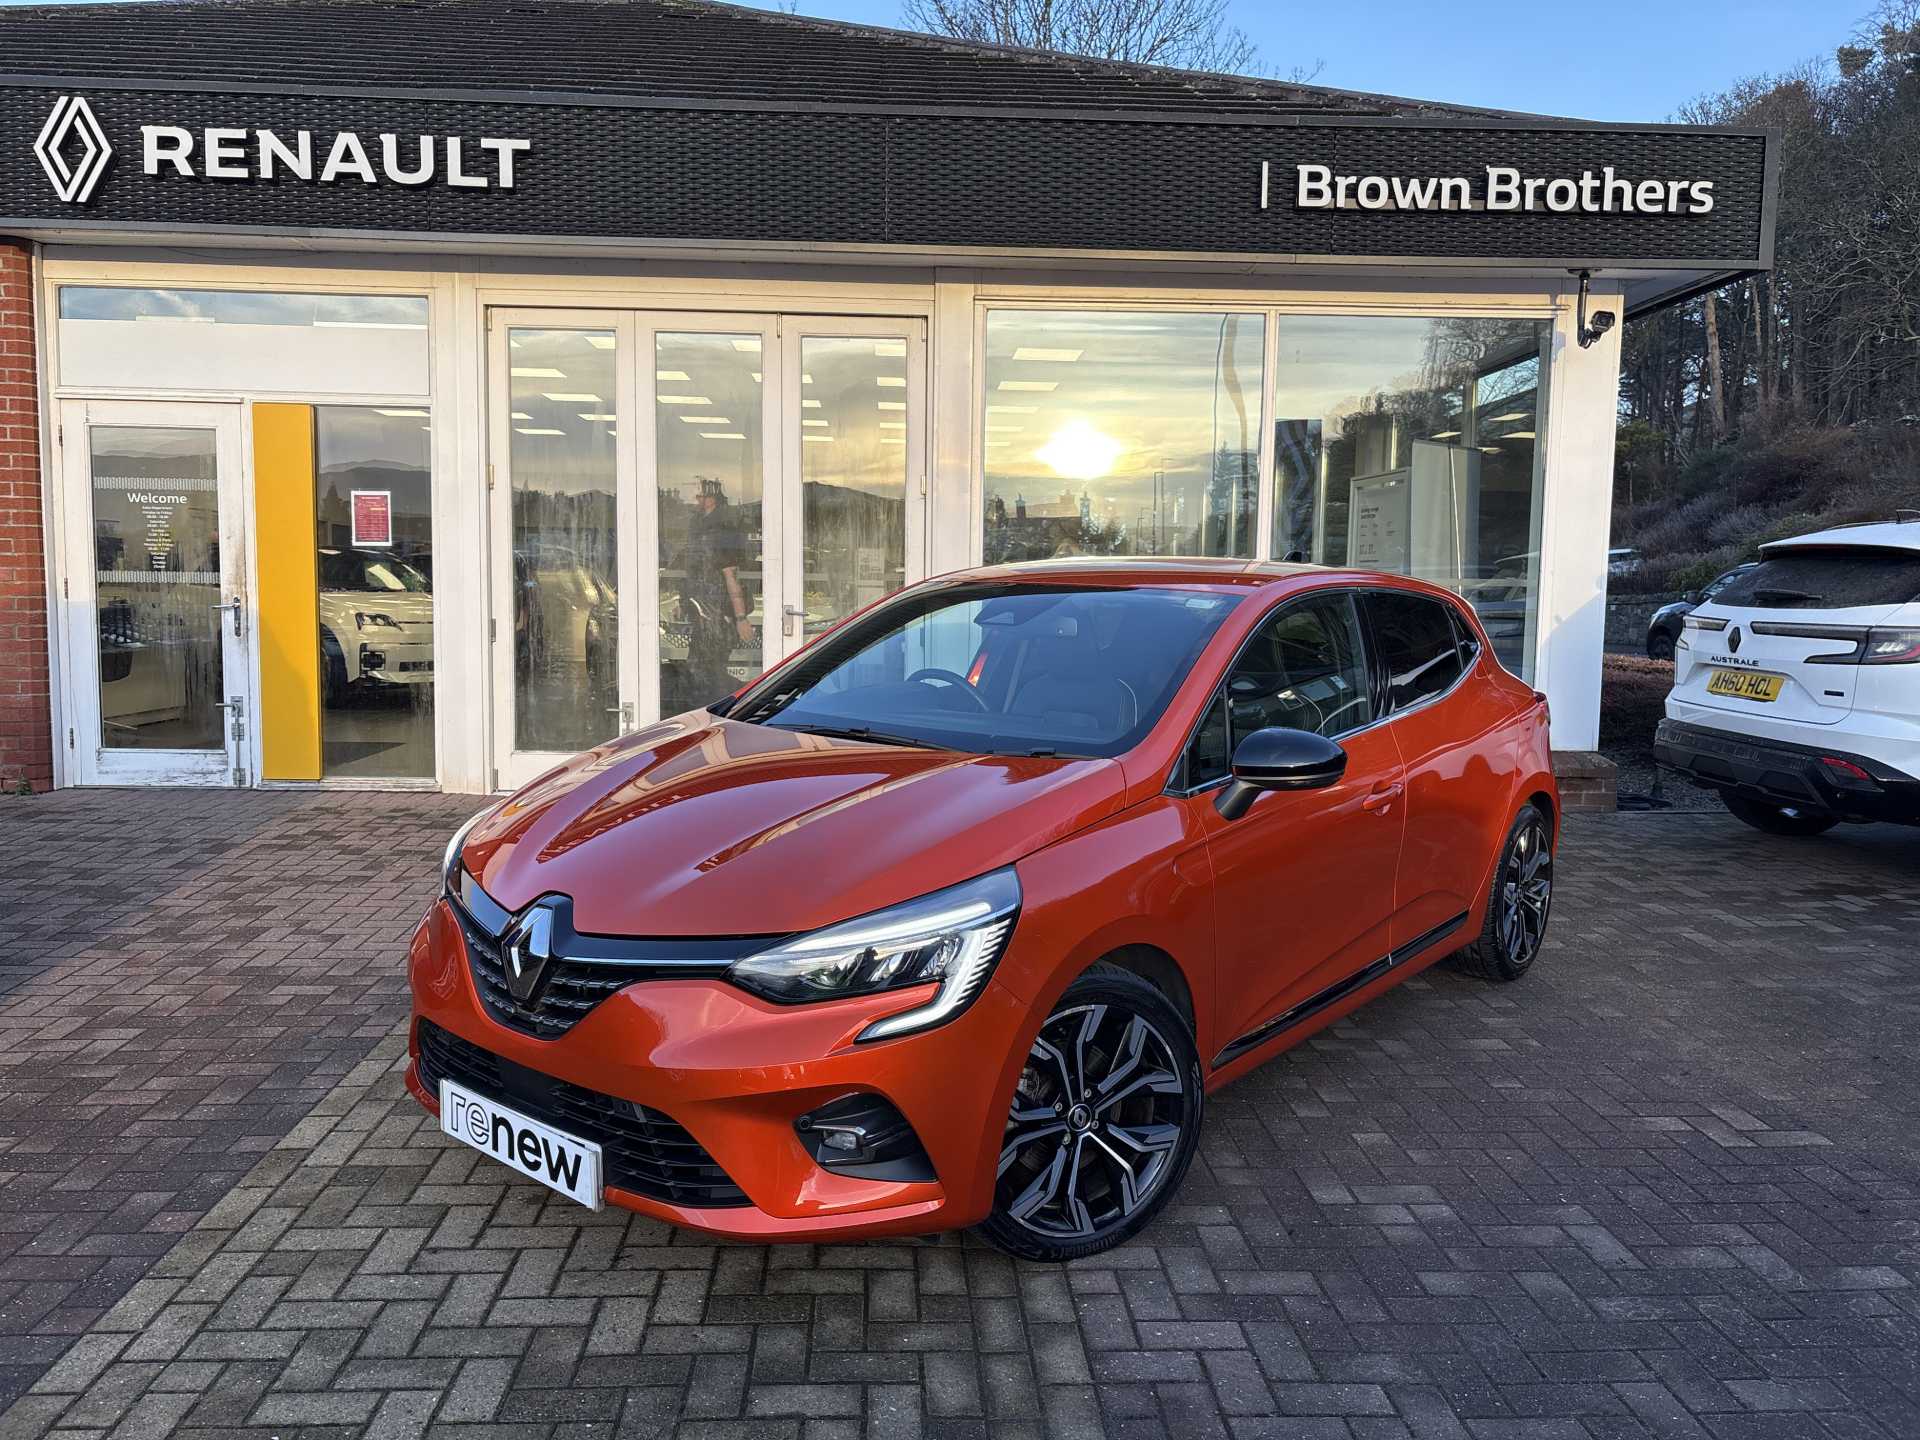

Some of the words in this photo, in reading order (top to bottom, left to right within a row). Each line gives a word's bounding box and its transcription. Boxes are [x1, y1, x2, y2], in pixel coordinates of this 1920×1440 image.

[140, 125, 531, 188] RENAULT
[1297, 164, 1471, 210] Brown
[1486, 165, 1714, 213] Brothers
[127, 492, 188, 504] Welcome
[1711, 655, 1760, 666] AUSTRALE
[450, 1091, 583, 1192] renew
